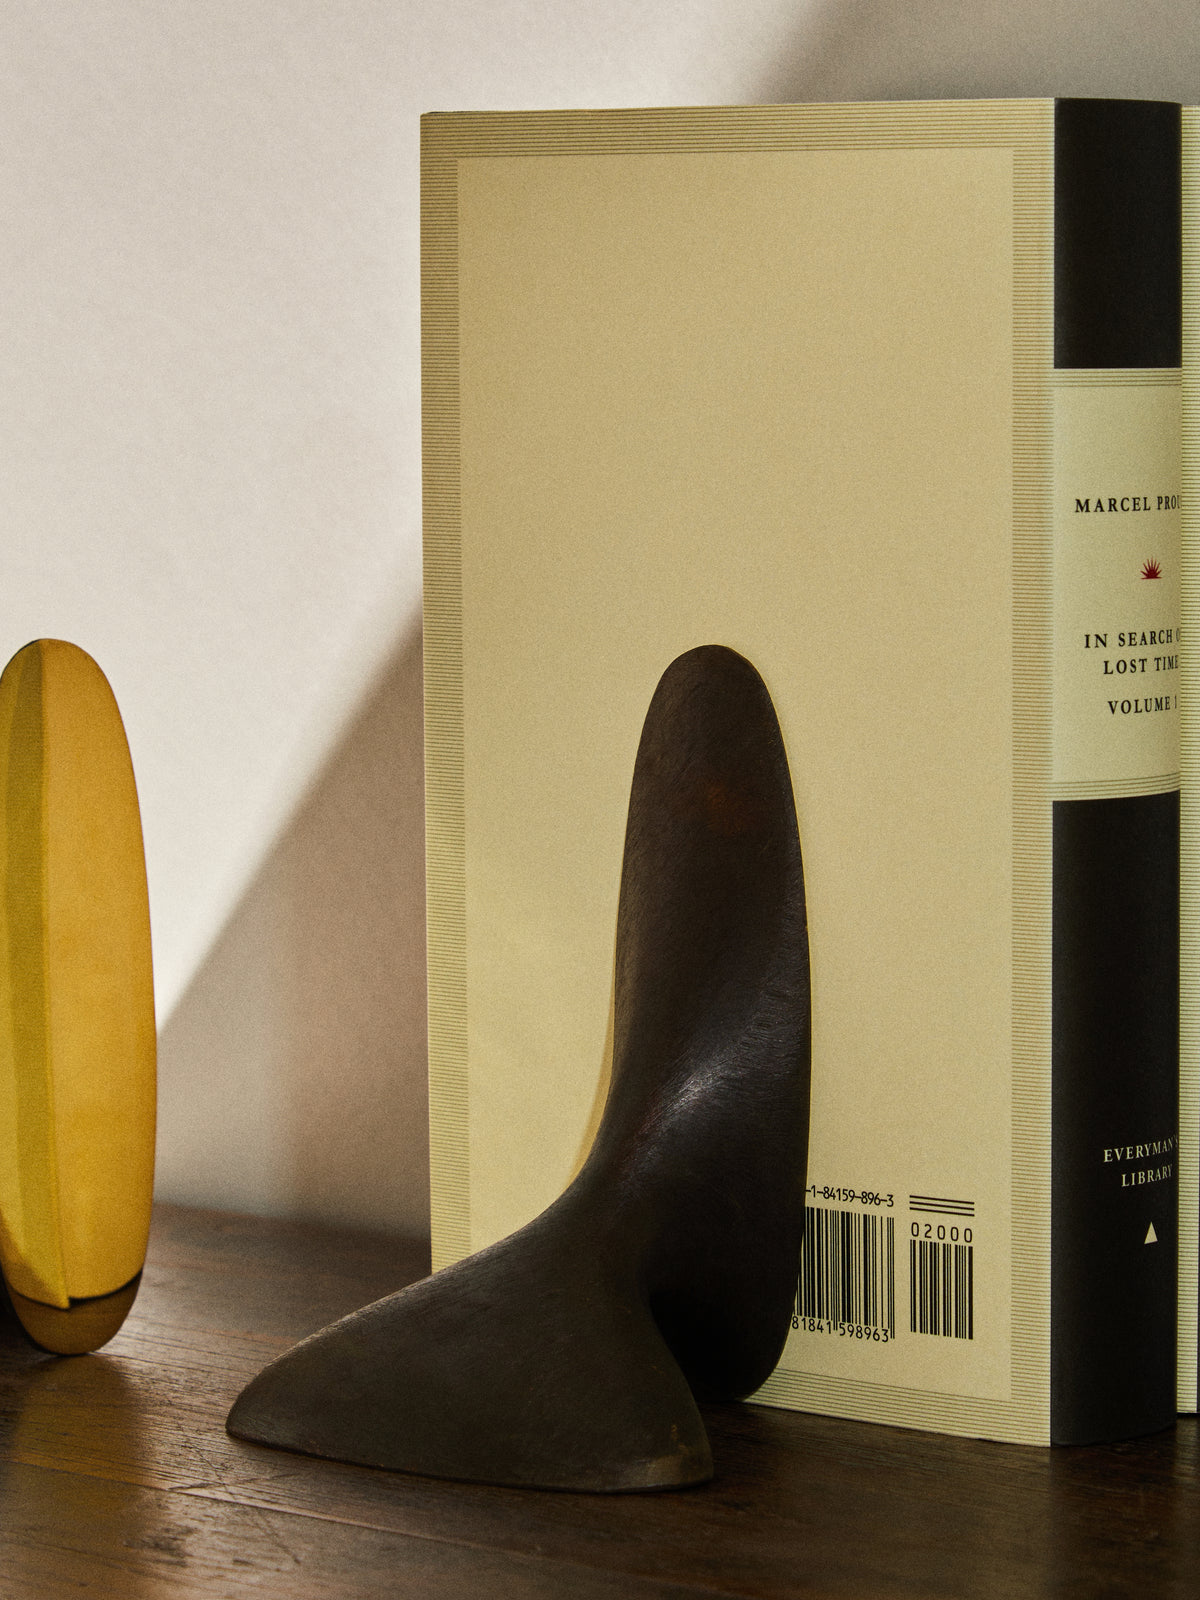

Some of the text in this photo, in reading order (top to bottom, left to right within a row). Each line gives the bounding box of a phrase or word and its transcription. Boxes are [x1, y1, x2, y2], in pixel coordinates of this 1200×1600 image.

[1075, 496, 1151, 513] MARCEL
[1084, 633, 1108, 649] IN
[1118, 629, 1173, 647] SEARCH
[1103, 655, 1179, 675] LOST TIME
[1107, 696, 1171, 715] VOLUME
[1121, 1163, 1174, 1188] LIBRARY
[910, 1221, 973, 1243] 02000
